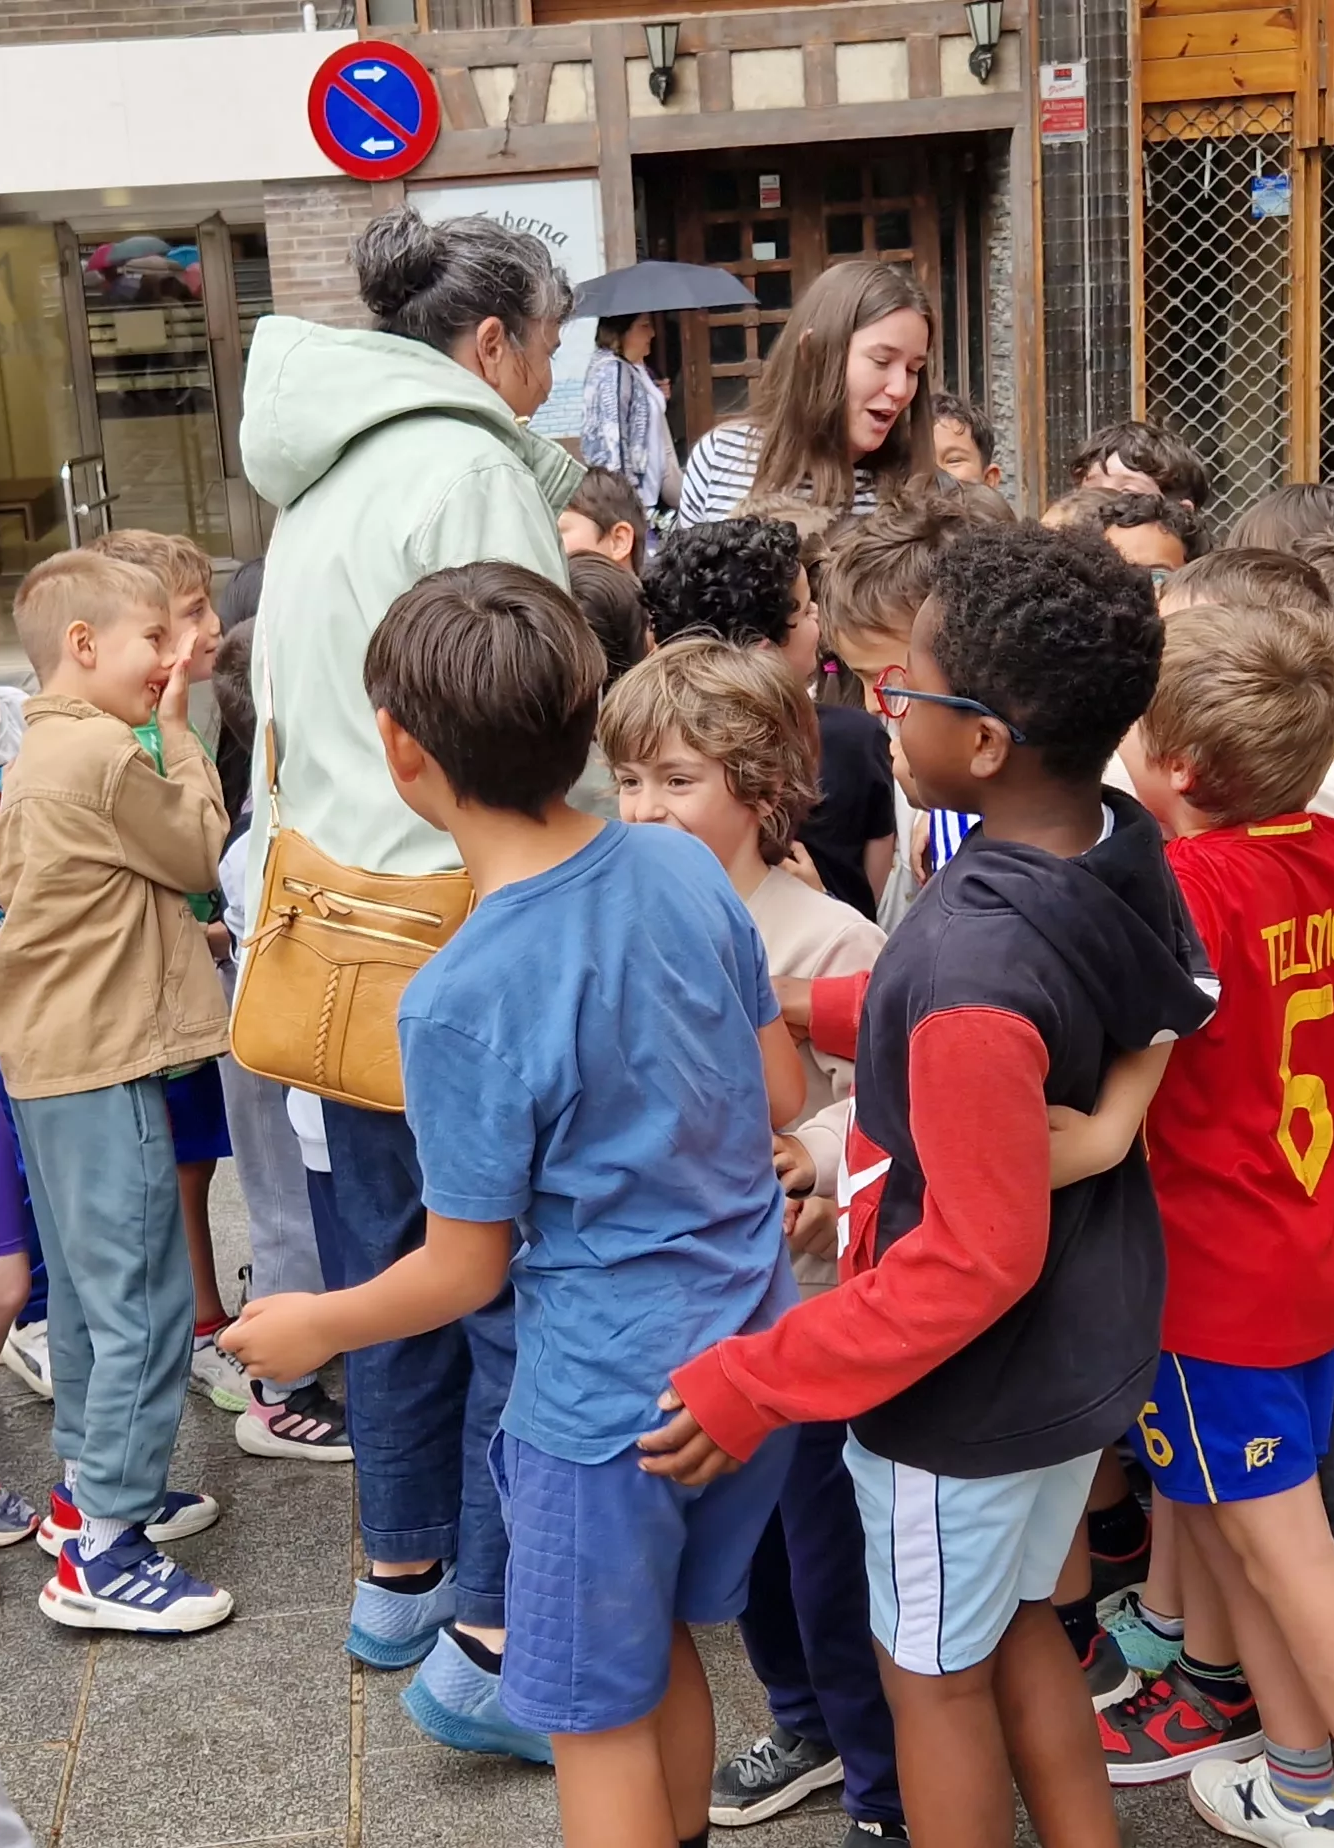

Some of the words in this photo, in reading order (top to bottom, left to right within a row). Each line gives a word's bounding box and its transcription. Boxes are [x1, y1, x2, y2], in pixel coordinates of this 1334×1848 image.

[472, 210, 570, 248] berna
[1276, 983, 1334, 1198] 6
[1137, 1401, 1174, 1467] 6
